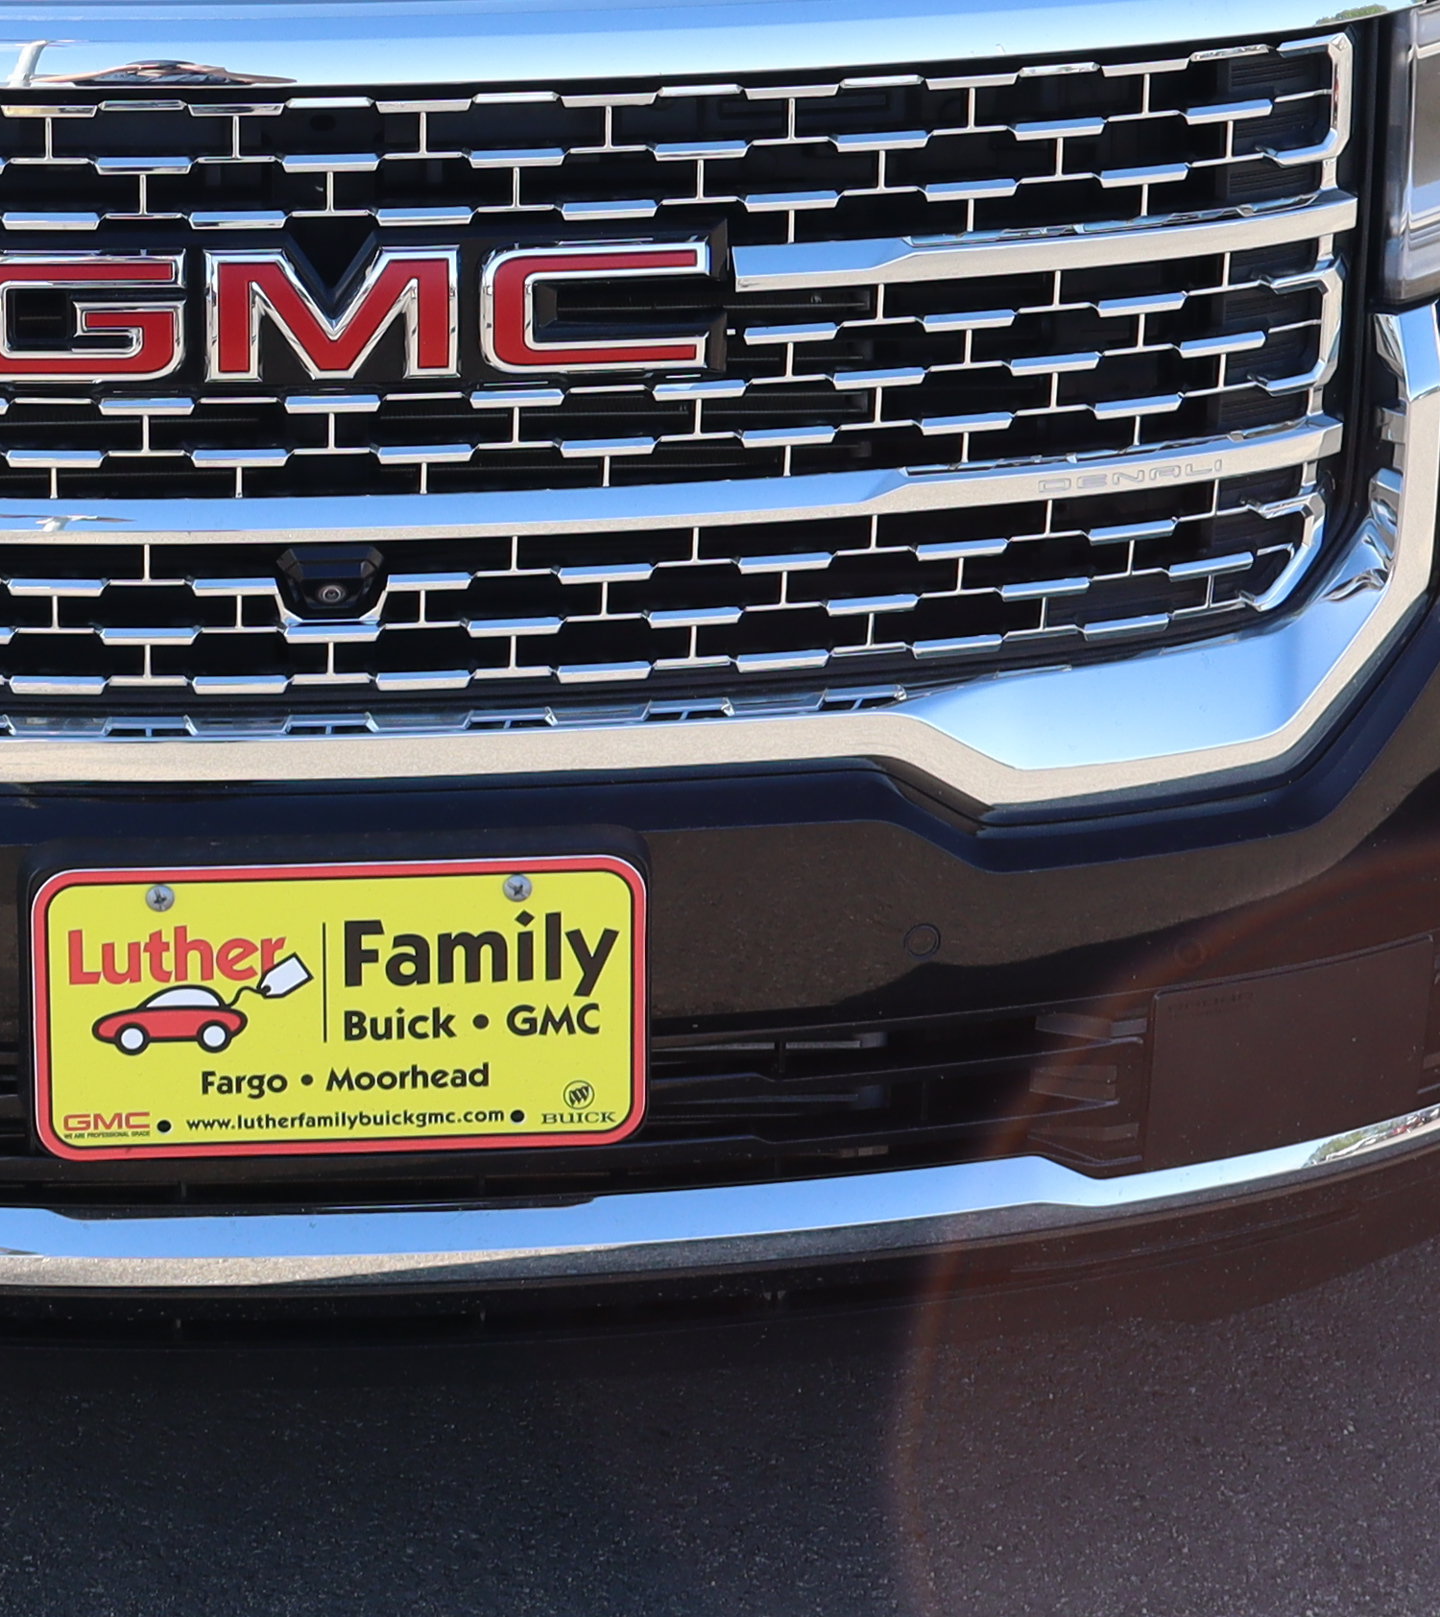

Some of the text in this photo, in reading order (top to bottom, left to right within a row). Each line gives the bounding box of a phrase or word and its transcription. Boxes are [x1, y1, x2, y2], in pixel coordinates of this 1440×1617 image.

[1037, 458, 1223, 493] DENALI
[67, 910, 620, 997] Luther Family
[343, 1003, 601, 1042] Buick GMC
[201, 1062, 490, 1100] Fargo Moorhead
[63, 1112, 151, 1132] GMC
[186, 1108, 505, 1131] www.lutherfamilybuickgmc.com
[541, 1111, 616, 1125] BUICK
